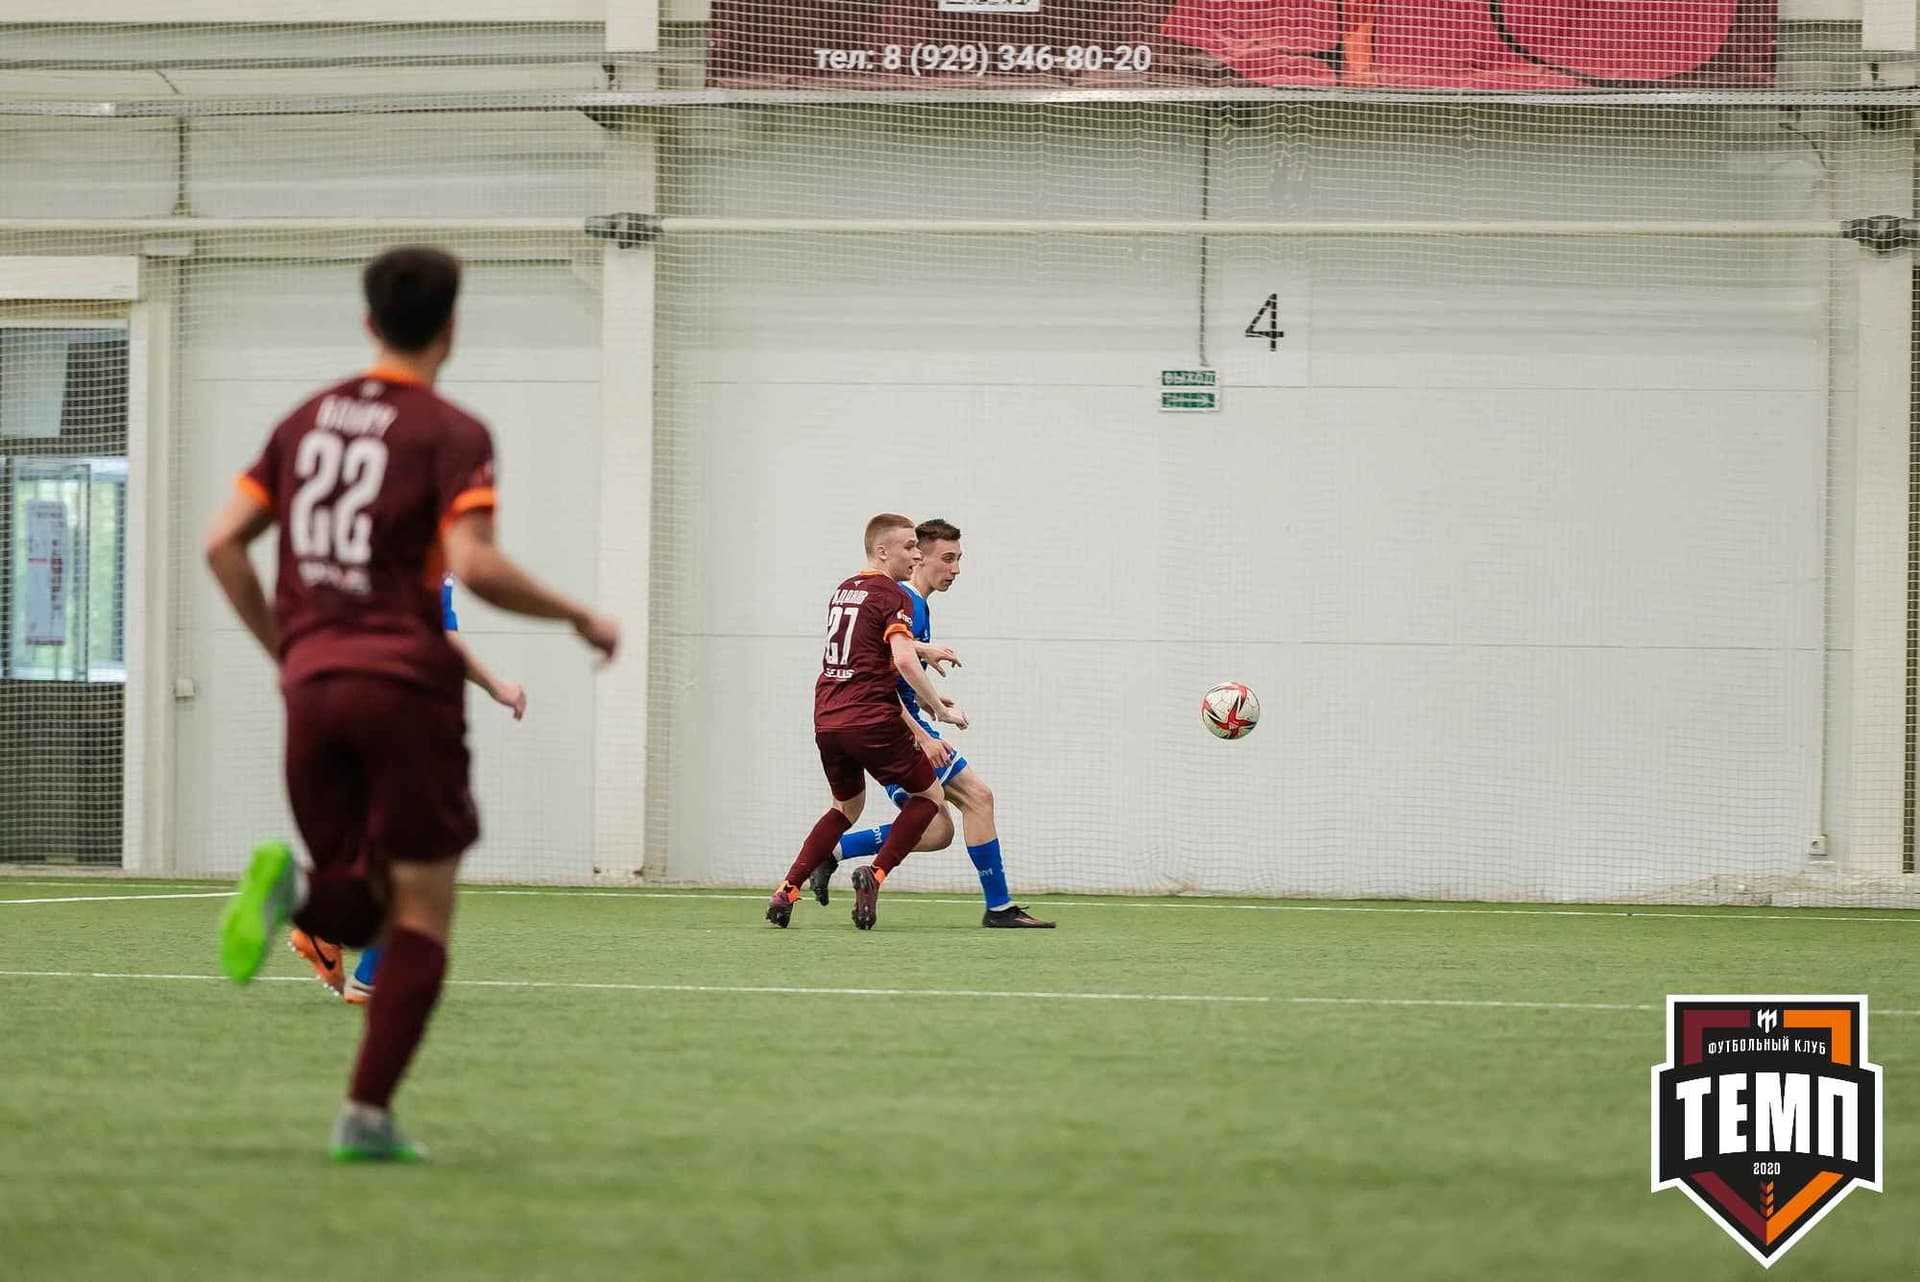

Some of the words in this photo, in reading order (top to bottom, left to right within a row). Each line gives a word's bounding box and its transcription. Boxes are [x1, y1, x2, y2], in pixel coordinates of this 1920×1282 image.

[815, 48, 874, 71] тел:
[882, 44, 902, 71] 8
[910, 42, 989, 76] (929)
[998, 44, 1151, 72] 346-80-20
[1245, 293, 1285, 352] 4
[289, 429, 390, 565] 22
[824, 606, 859, 666] 27
